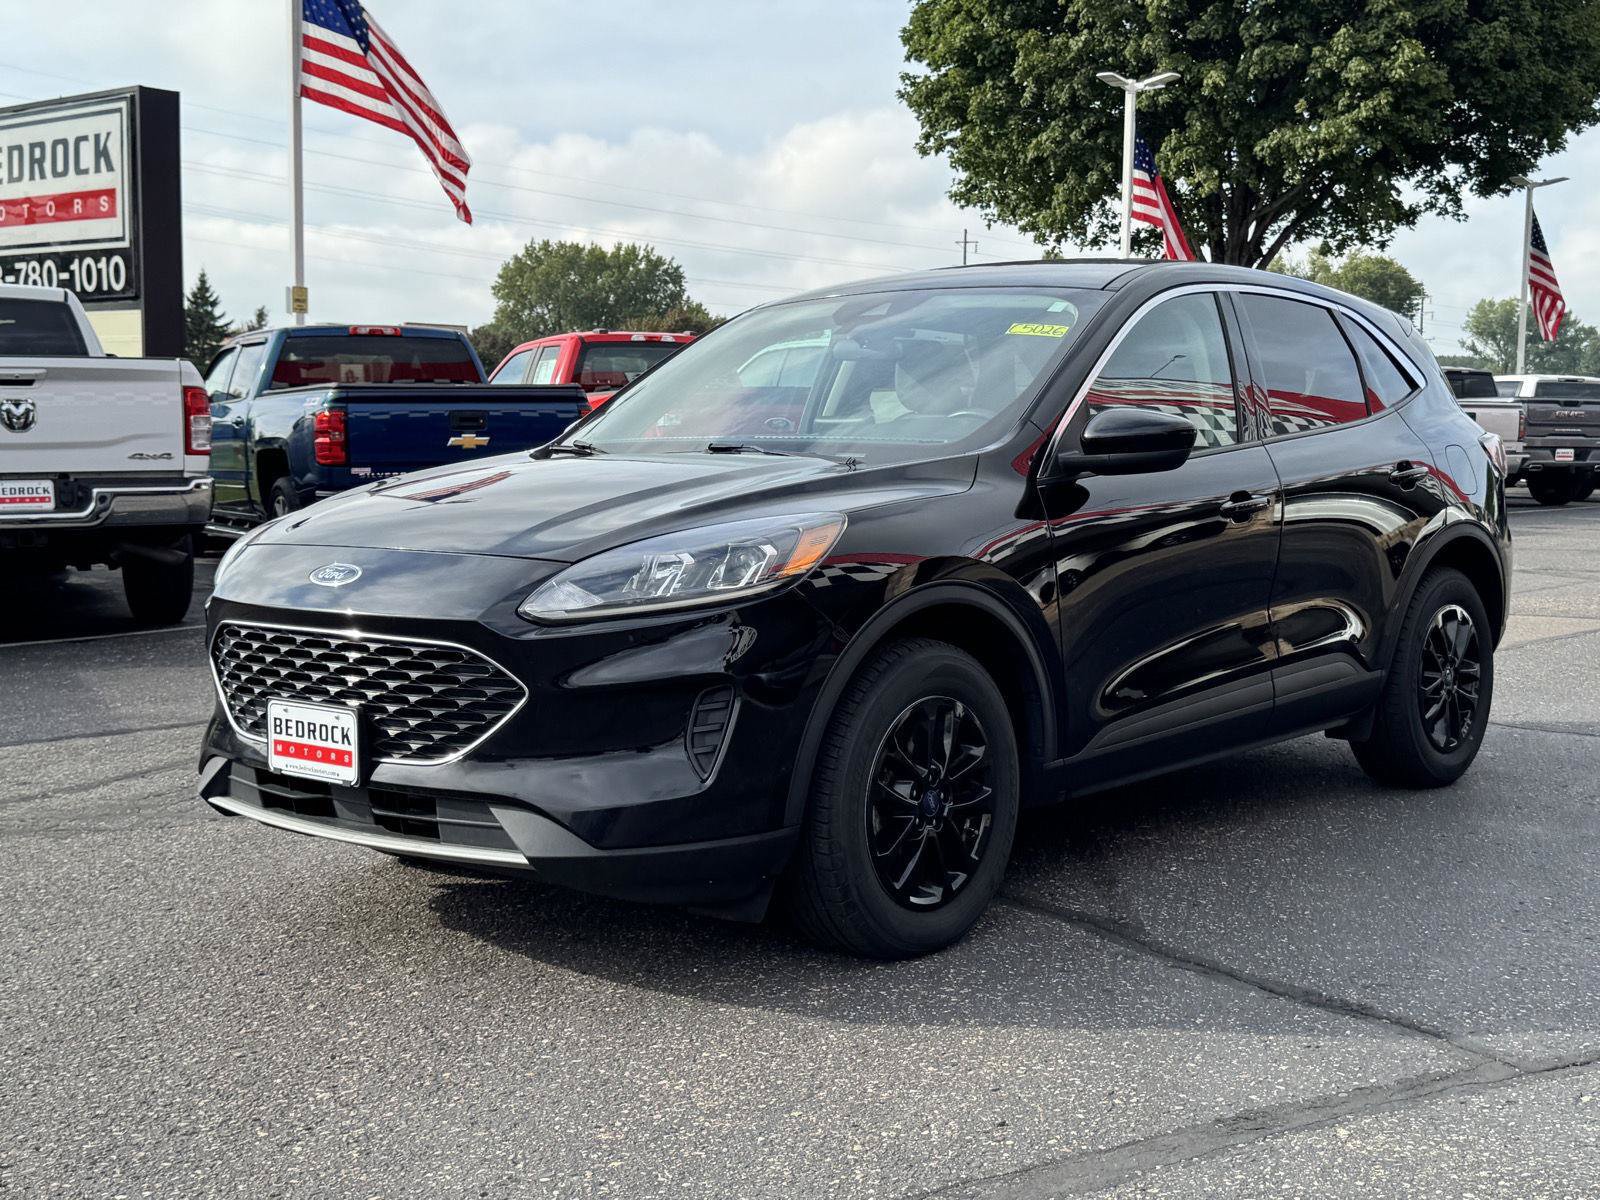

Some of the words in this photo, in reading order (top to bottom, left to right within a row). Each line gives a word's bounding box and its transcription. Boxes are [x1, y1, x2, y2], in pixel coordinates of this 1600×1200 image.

[0, 131, 115, 185] DROCK
[0, 255, 126, 292] -780-1010
[317, 565, 350, 581] Ford
[273, 717, 352, 746] BEDROCK
[276, 743, 350, 763] MOTORS
